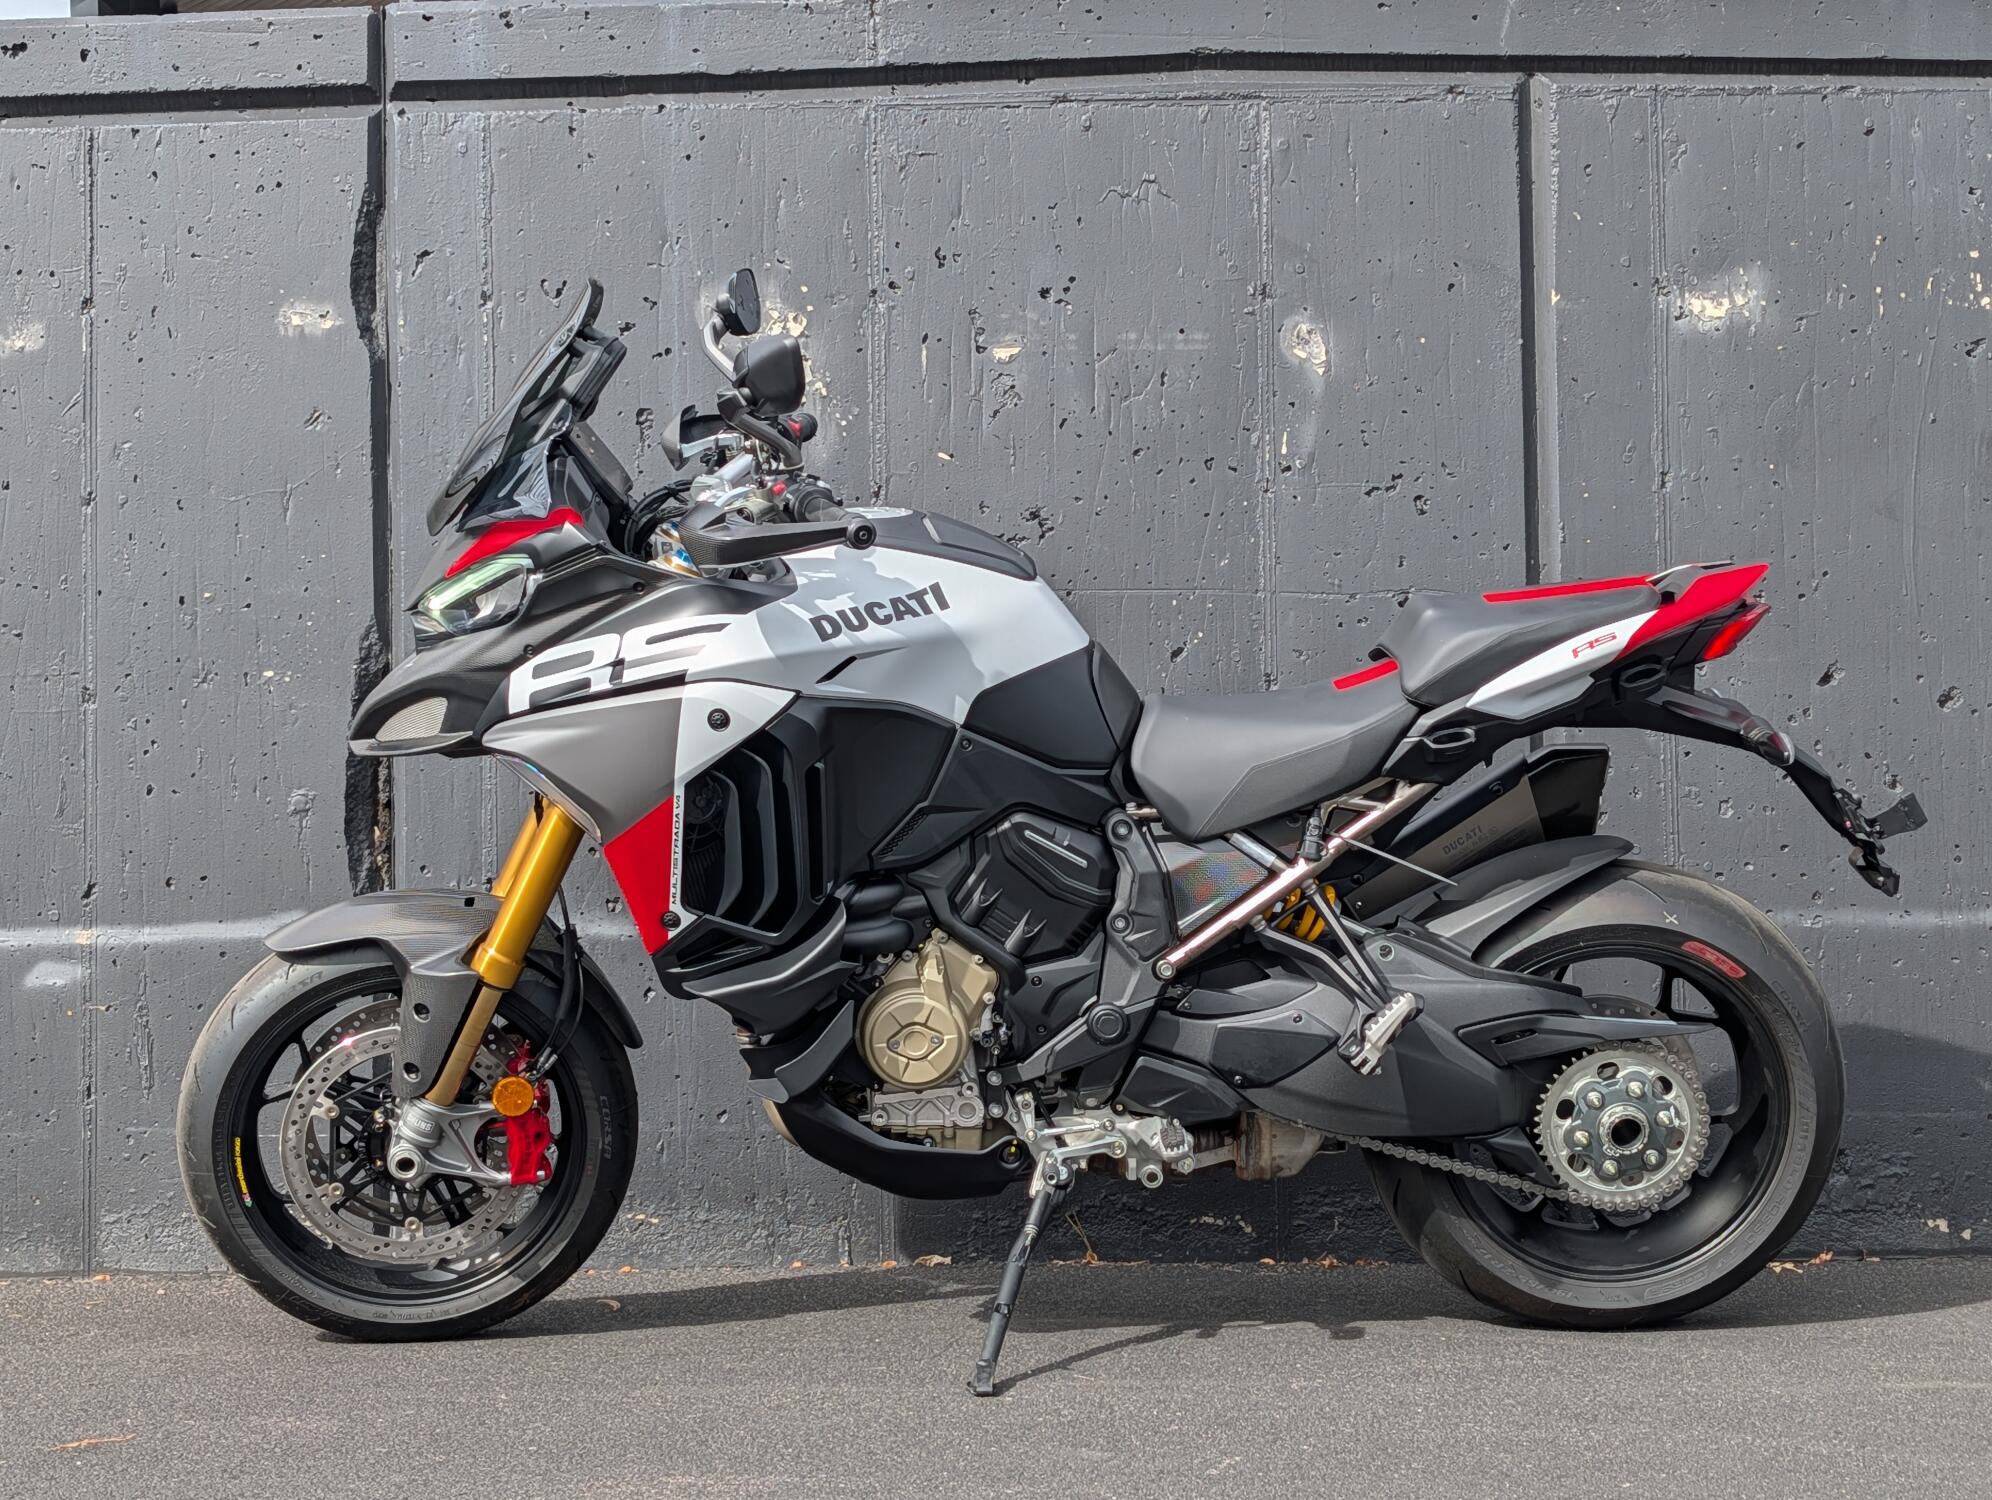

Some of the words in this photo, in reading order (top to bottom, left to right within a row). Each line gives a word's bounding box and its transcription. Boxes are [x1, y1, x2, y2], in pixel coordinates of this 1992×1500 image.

[808, 581, 951, 643] DUCATI
[509, 613, 736, 715] RS
[1572, 631, 1617, 659] RS
[675, 795, 681, 810] V4
[671, 813, 681, 905] MULTISTRADA
[1442, 824, 1483, 855] DUCATI
